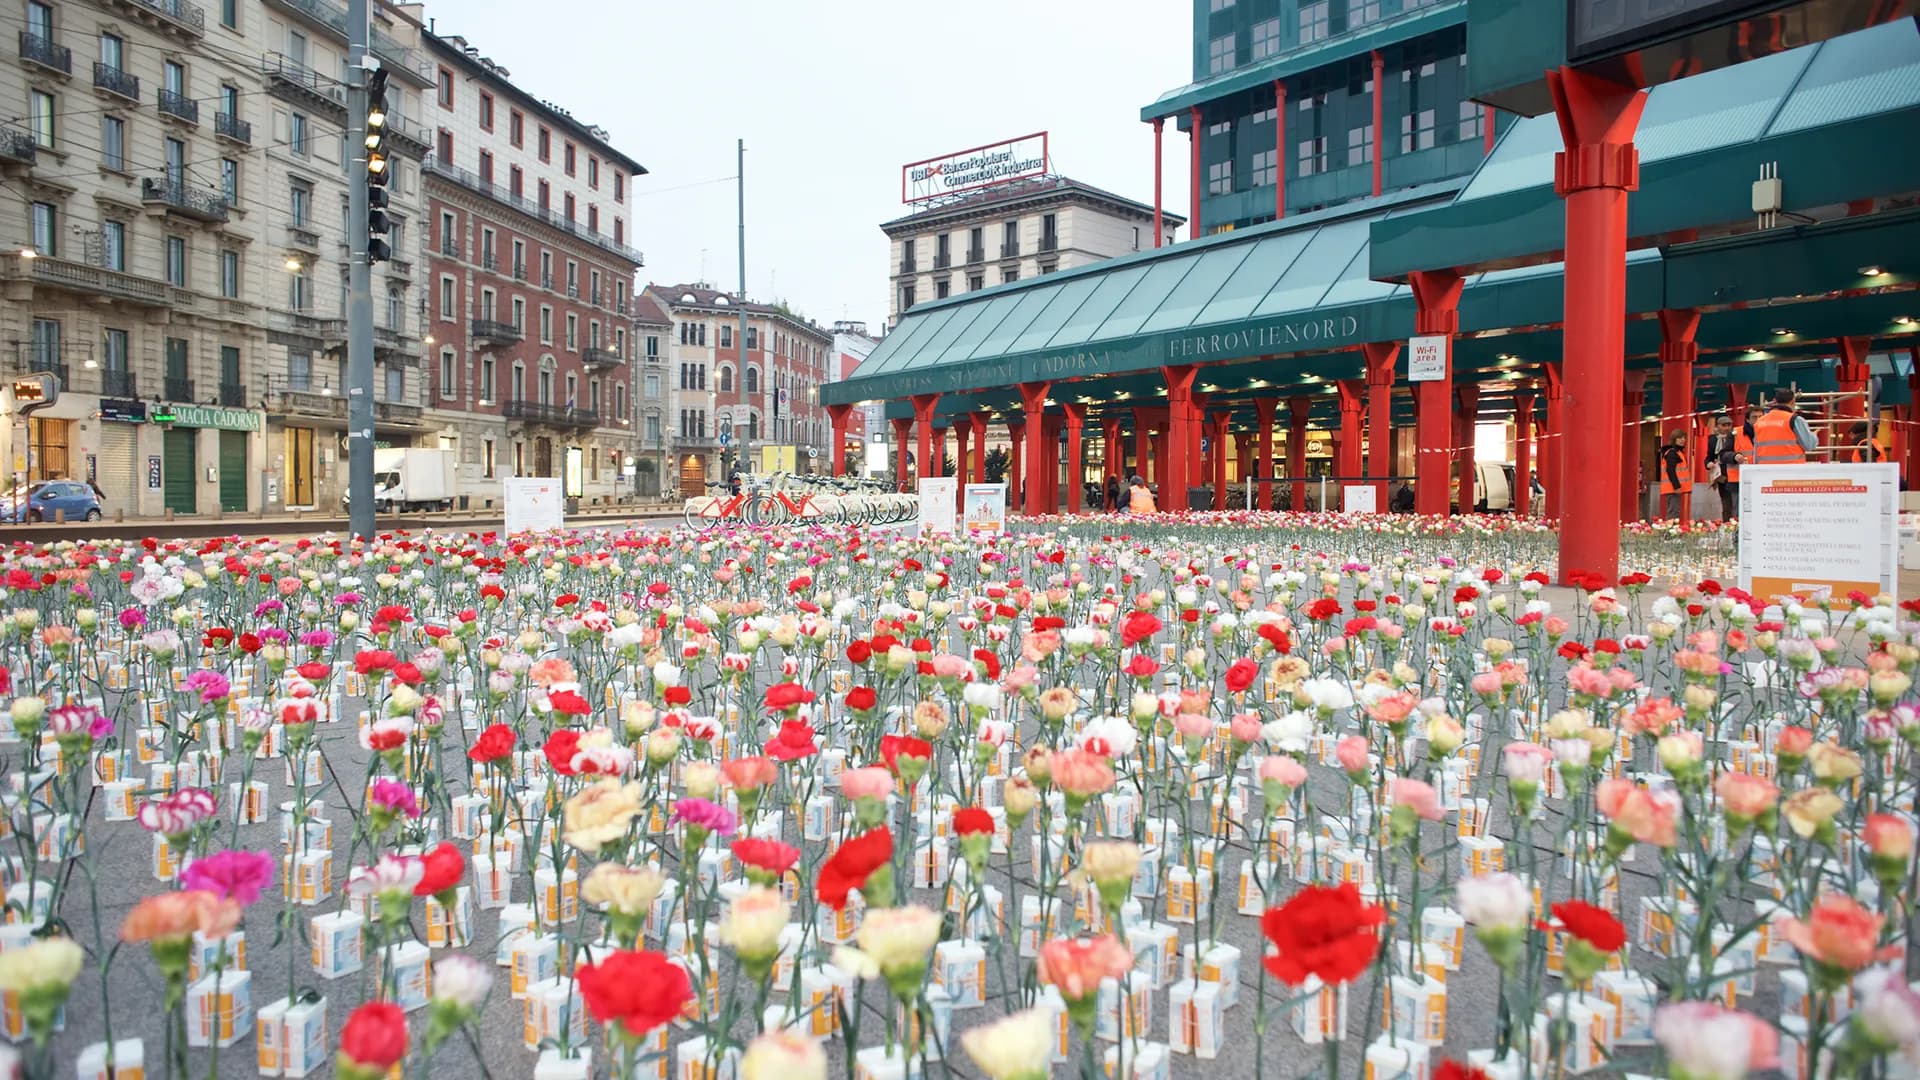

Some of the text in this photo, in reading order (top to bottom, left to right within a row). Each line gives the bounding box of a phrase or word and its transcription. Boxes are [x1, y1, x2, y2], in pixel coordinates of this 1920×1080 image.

[912, 151, 1010, 182] UBI Banca Popolare
[943, 168, 992, 188] Commercio
[1001, 157, 1042, 176] Industria
[1169, 315, 1358, 358] FERROVIENORD
[1032, 350, 1112, 375] CADORNA
[1416, 345, 1437, 355] Wi-Fi
[1416, 354, 1437, 362] area
[156, 405, 211, 425] FRMACIA
[213, 410, 260, 429] CADORNA
